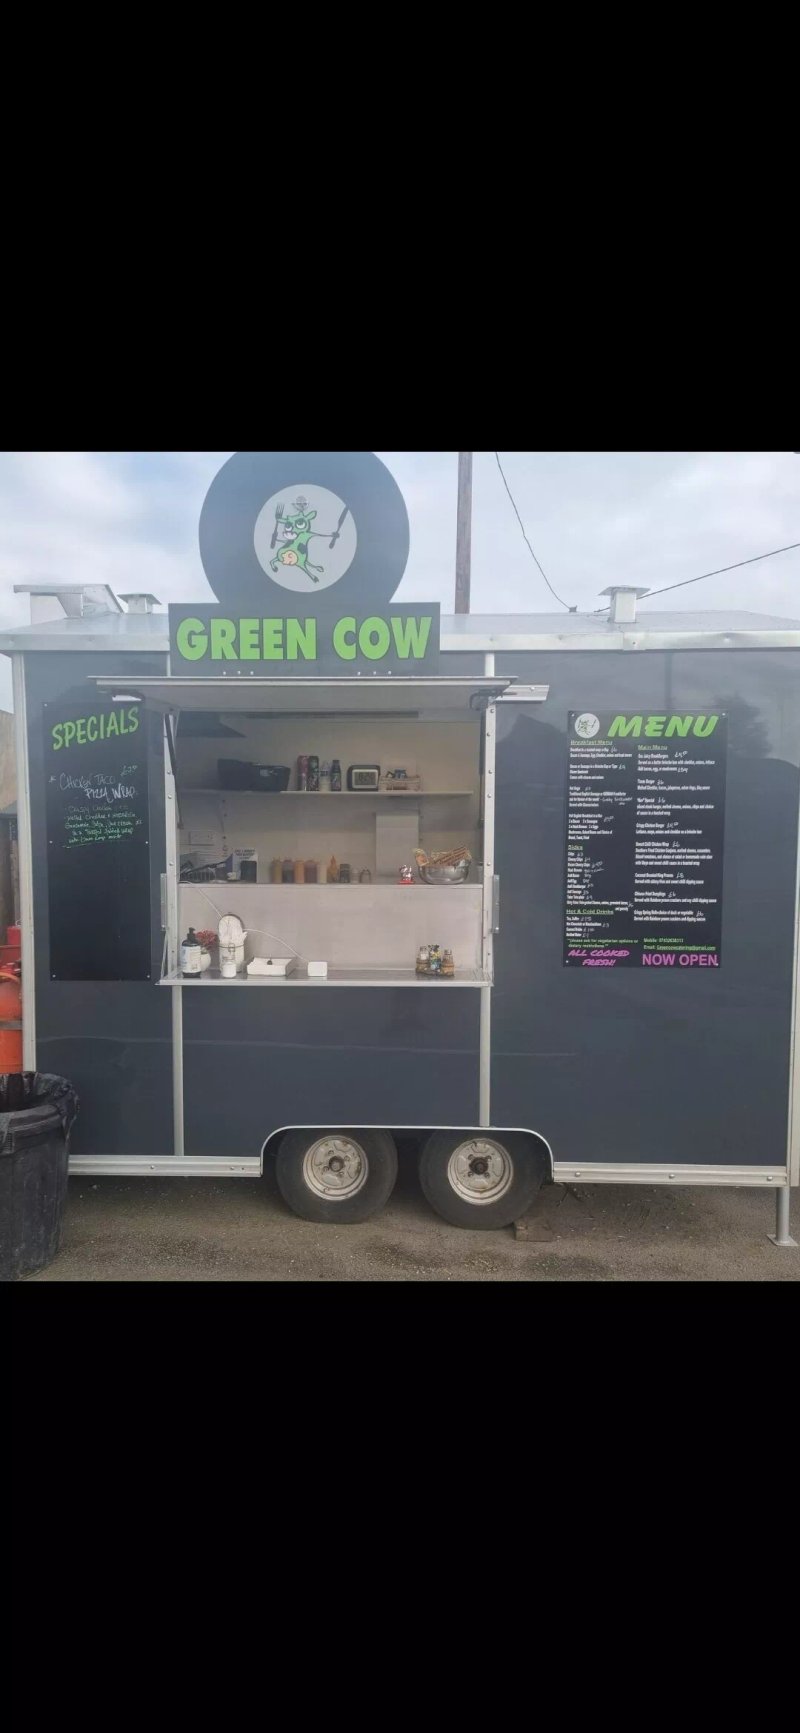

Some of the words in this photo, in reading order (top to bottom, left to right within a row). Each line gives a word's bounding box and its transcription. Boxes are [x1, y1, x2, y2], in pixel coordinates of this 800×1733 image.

[176, 618, 316, 660] GREEN
[332, 616, 432, 660] COW
[52, 706, 139, 750] SPECIALS
[607, 716, 719, 738] MENU
[582, 958, 616, 966] FRESH!
[642, 954, 676, 966] NOW
[678, 954, 718, 966] OPEN
